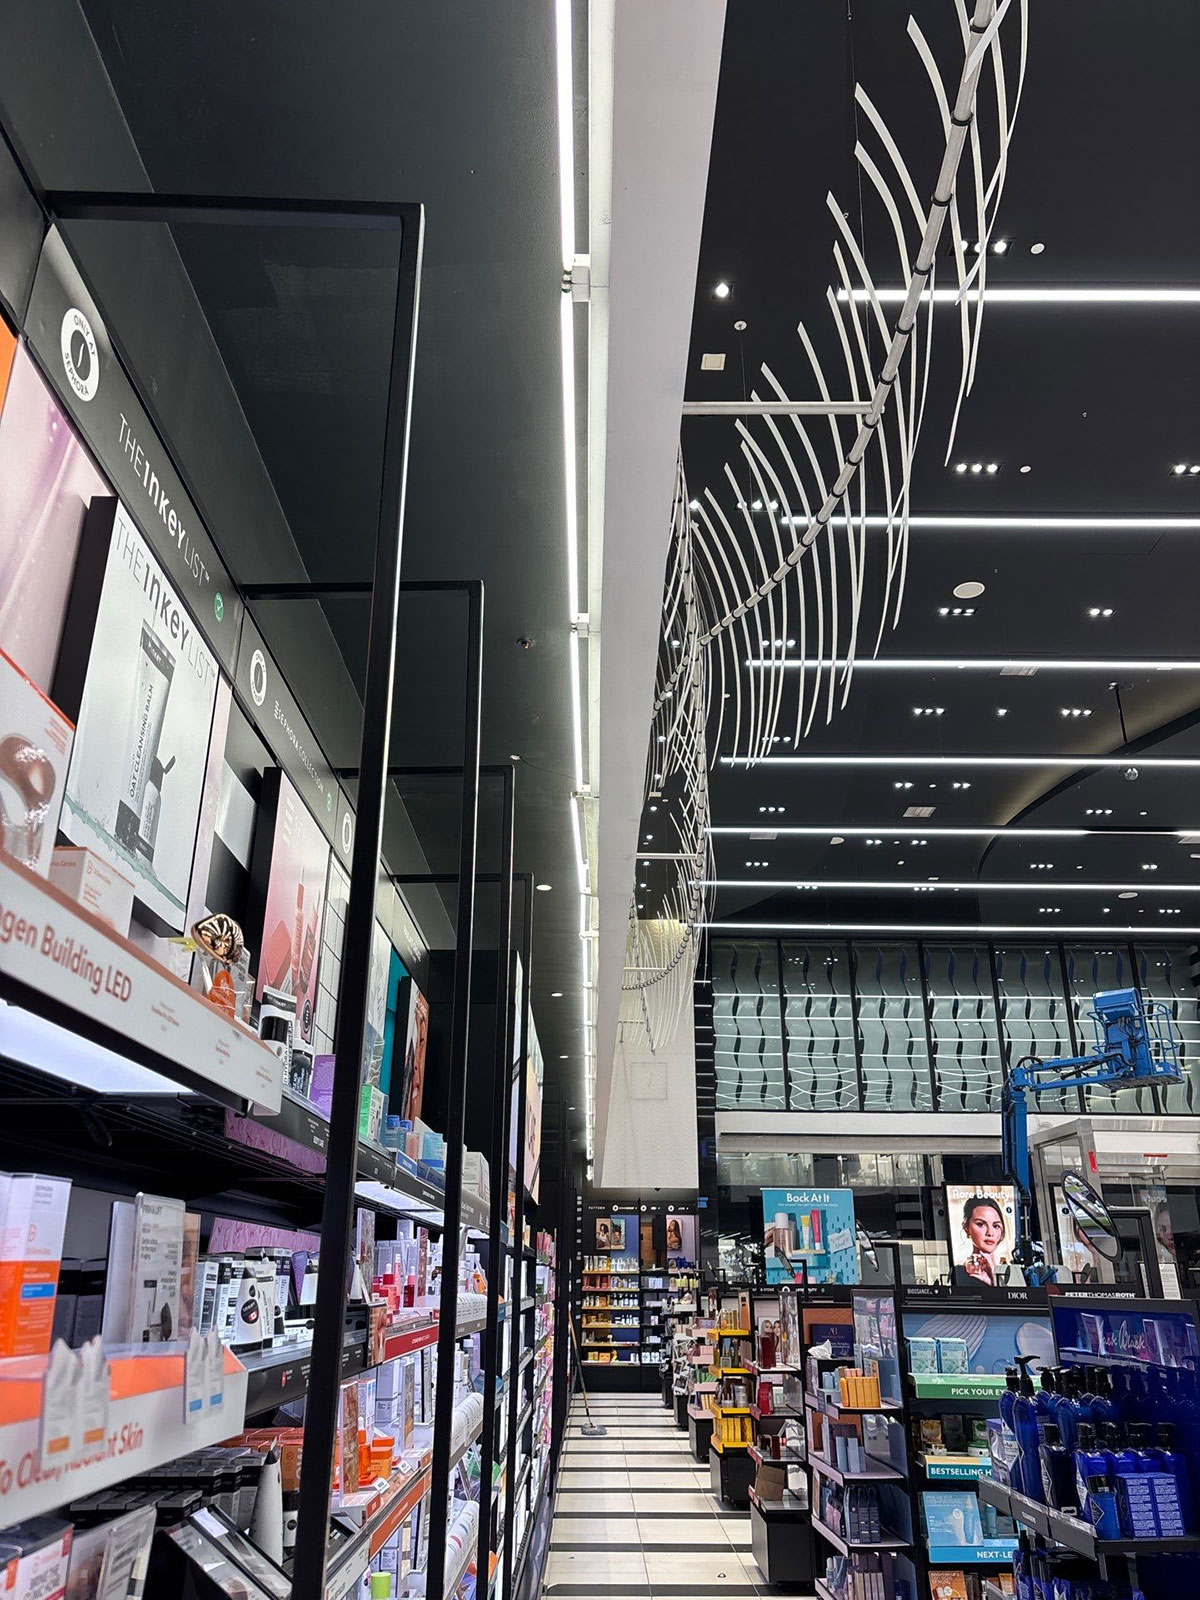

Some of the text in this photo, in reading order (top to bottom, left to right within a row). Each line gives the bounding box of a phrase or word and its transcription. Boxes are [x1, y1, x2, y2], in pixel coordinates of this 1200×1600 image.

[64, 352, 90, 397] SEPHORA
[119, 413, 144, 478] THE
[116, 517, 144, 583] THE
[134, 713, 149, 773] CLEANSING
[145, 684, 155, 713] BALM
[278, 709, 324, 793] SEPHORA COLLECTION
[0, 903, 133, 1003] gen Building LED
[786, 1192, 830, 1203] Back At It
[952, 1189, 1010, 1201] Rare Beauty
[1007, 1291, 1028, 1300] DIOR
[951, 1388, 969, 1396] PICK
[971, 1388, 993, 1396] YOUR
[118, 1422, 144, 1455] Skin
[930, 1467, 984, 1476] BESTSELLING
